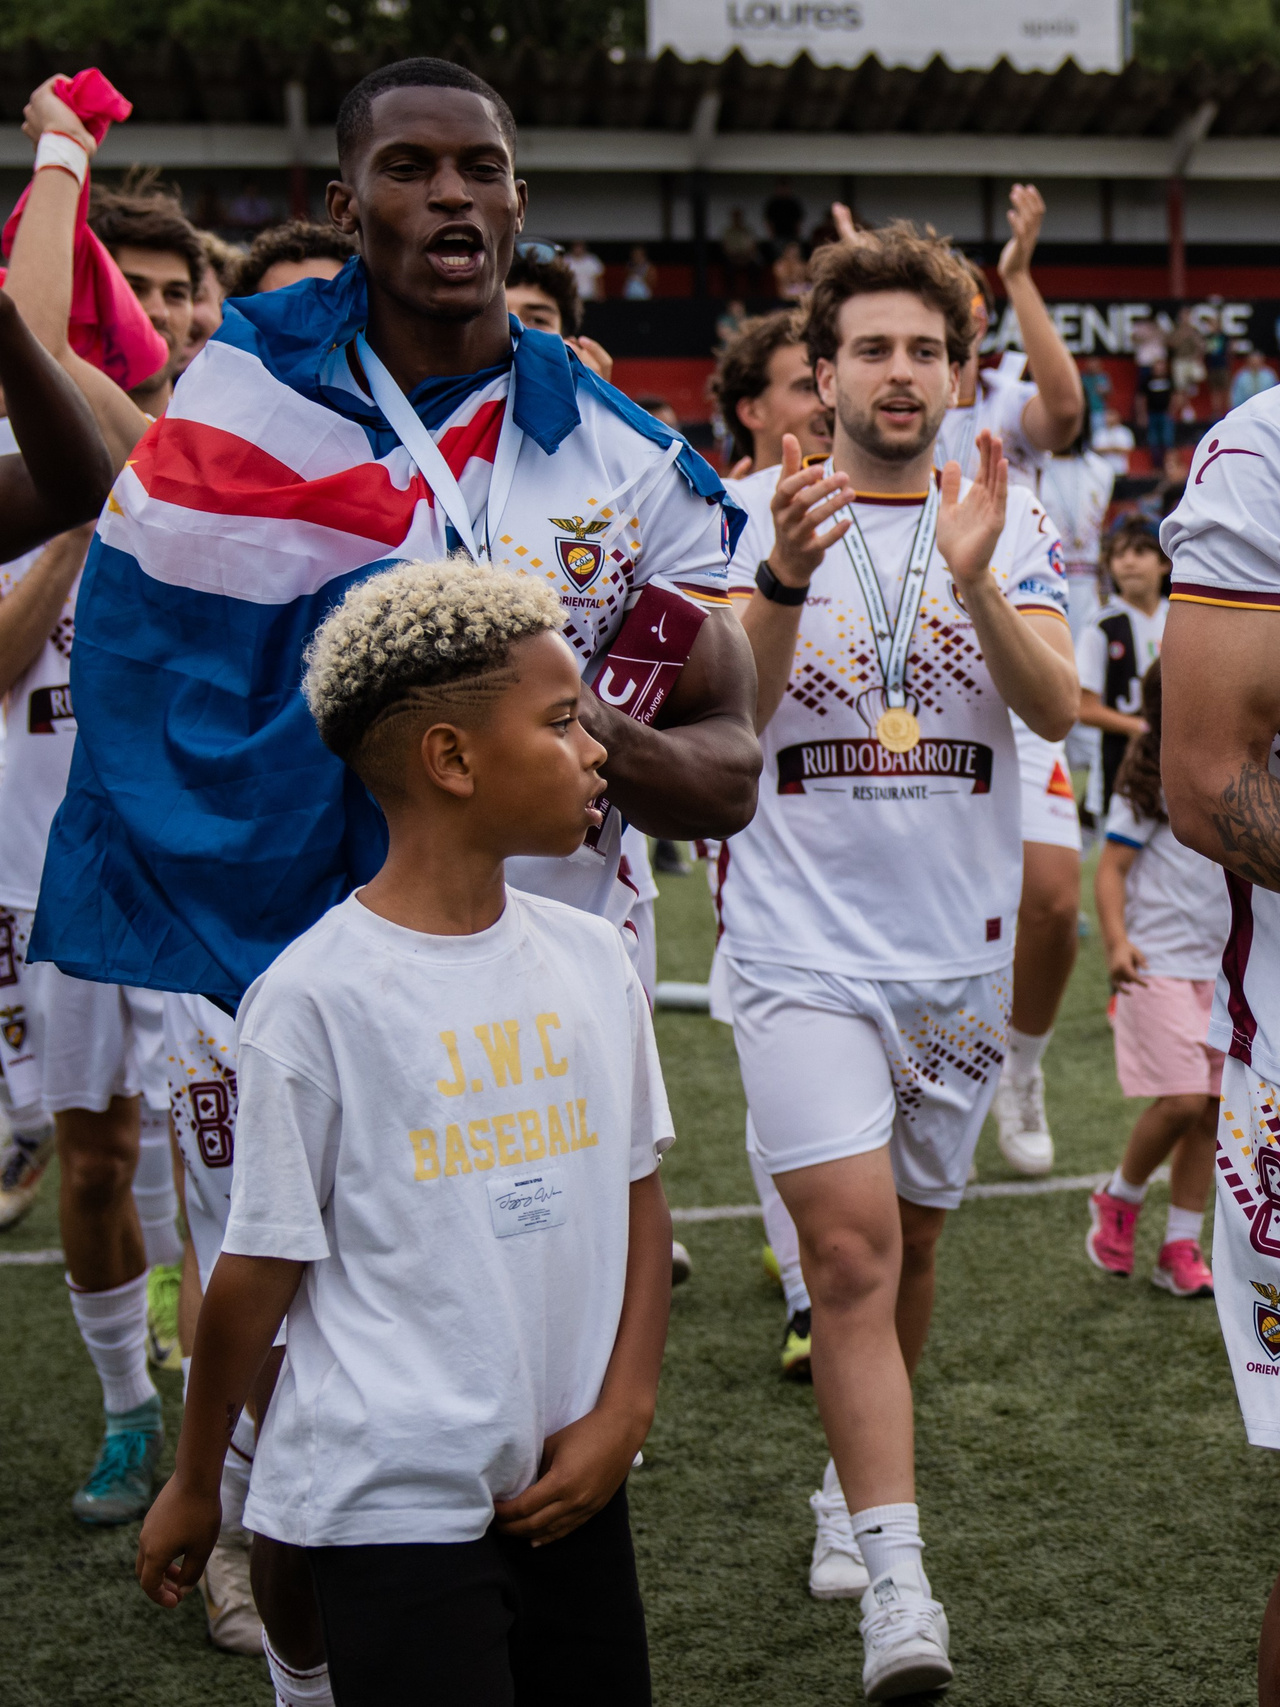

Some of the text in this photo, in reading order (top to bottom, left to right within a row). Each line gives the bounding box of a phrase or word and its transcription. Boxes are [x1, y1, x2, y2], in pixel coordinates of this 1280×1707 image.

[726, 0, 863, 32] Loures
[644, 687, 665, 723] PLAYOFF
[802, 747, 840, 775] RUI
[852, 785, 929, 801] RESTAURANTE
[188, 1080, 234, 1169] 8
